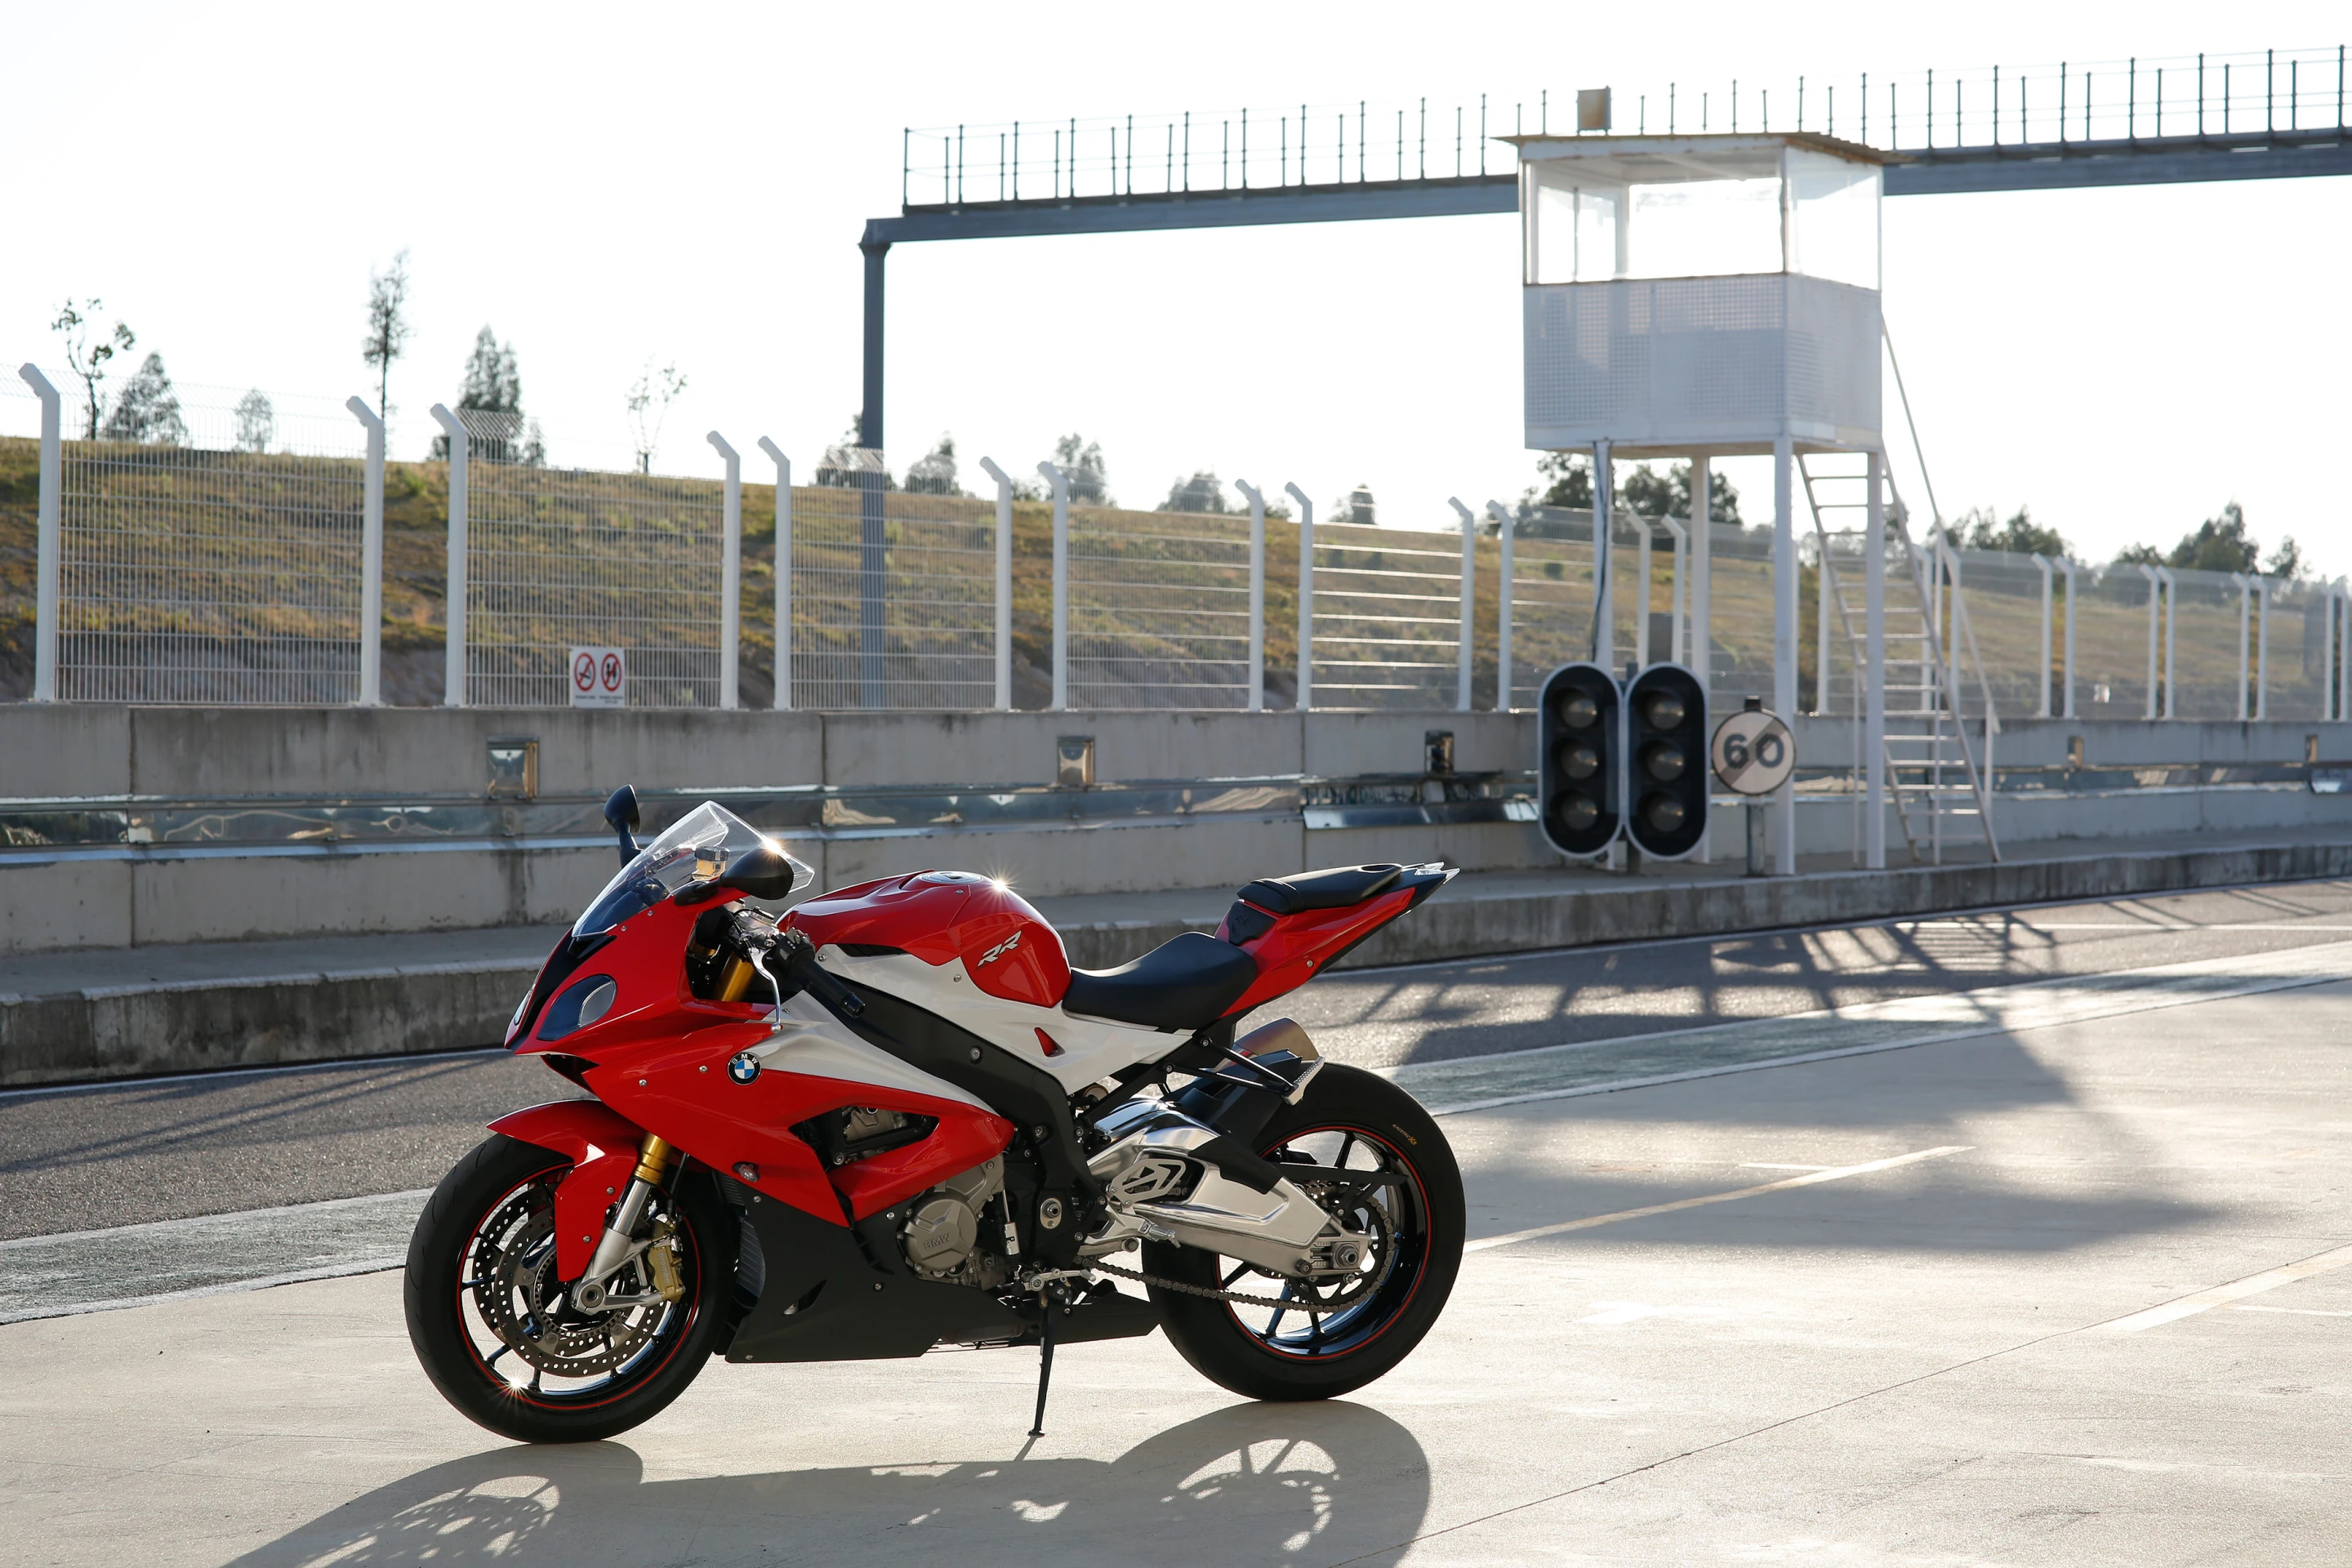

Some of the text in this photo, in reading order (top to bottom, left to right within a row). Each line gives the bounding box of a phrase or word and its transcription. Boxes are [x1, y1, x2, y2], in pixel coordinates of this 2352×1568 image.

[1724, 733, 1784, 769] 60
[978, 930, 1022, 967] RR
[731, 1054, 758, 1064] BMW
[924, 1232, 951, 1250] BMW
[659, 1253, 670, 1284] brembo
